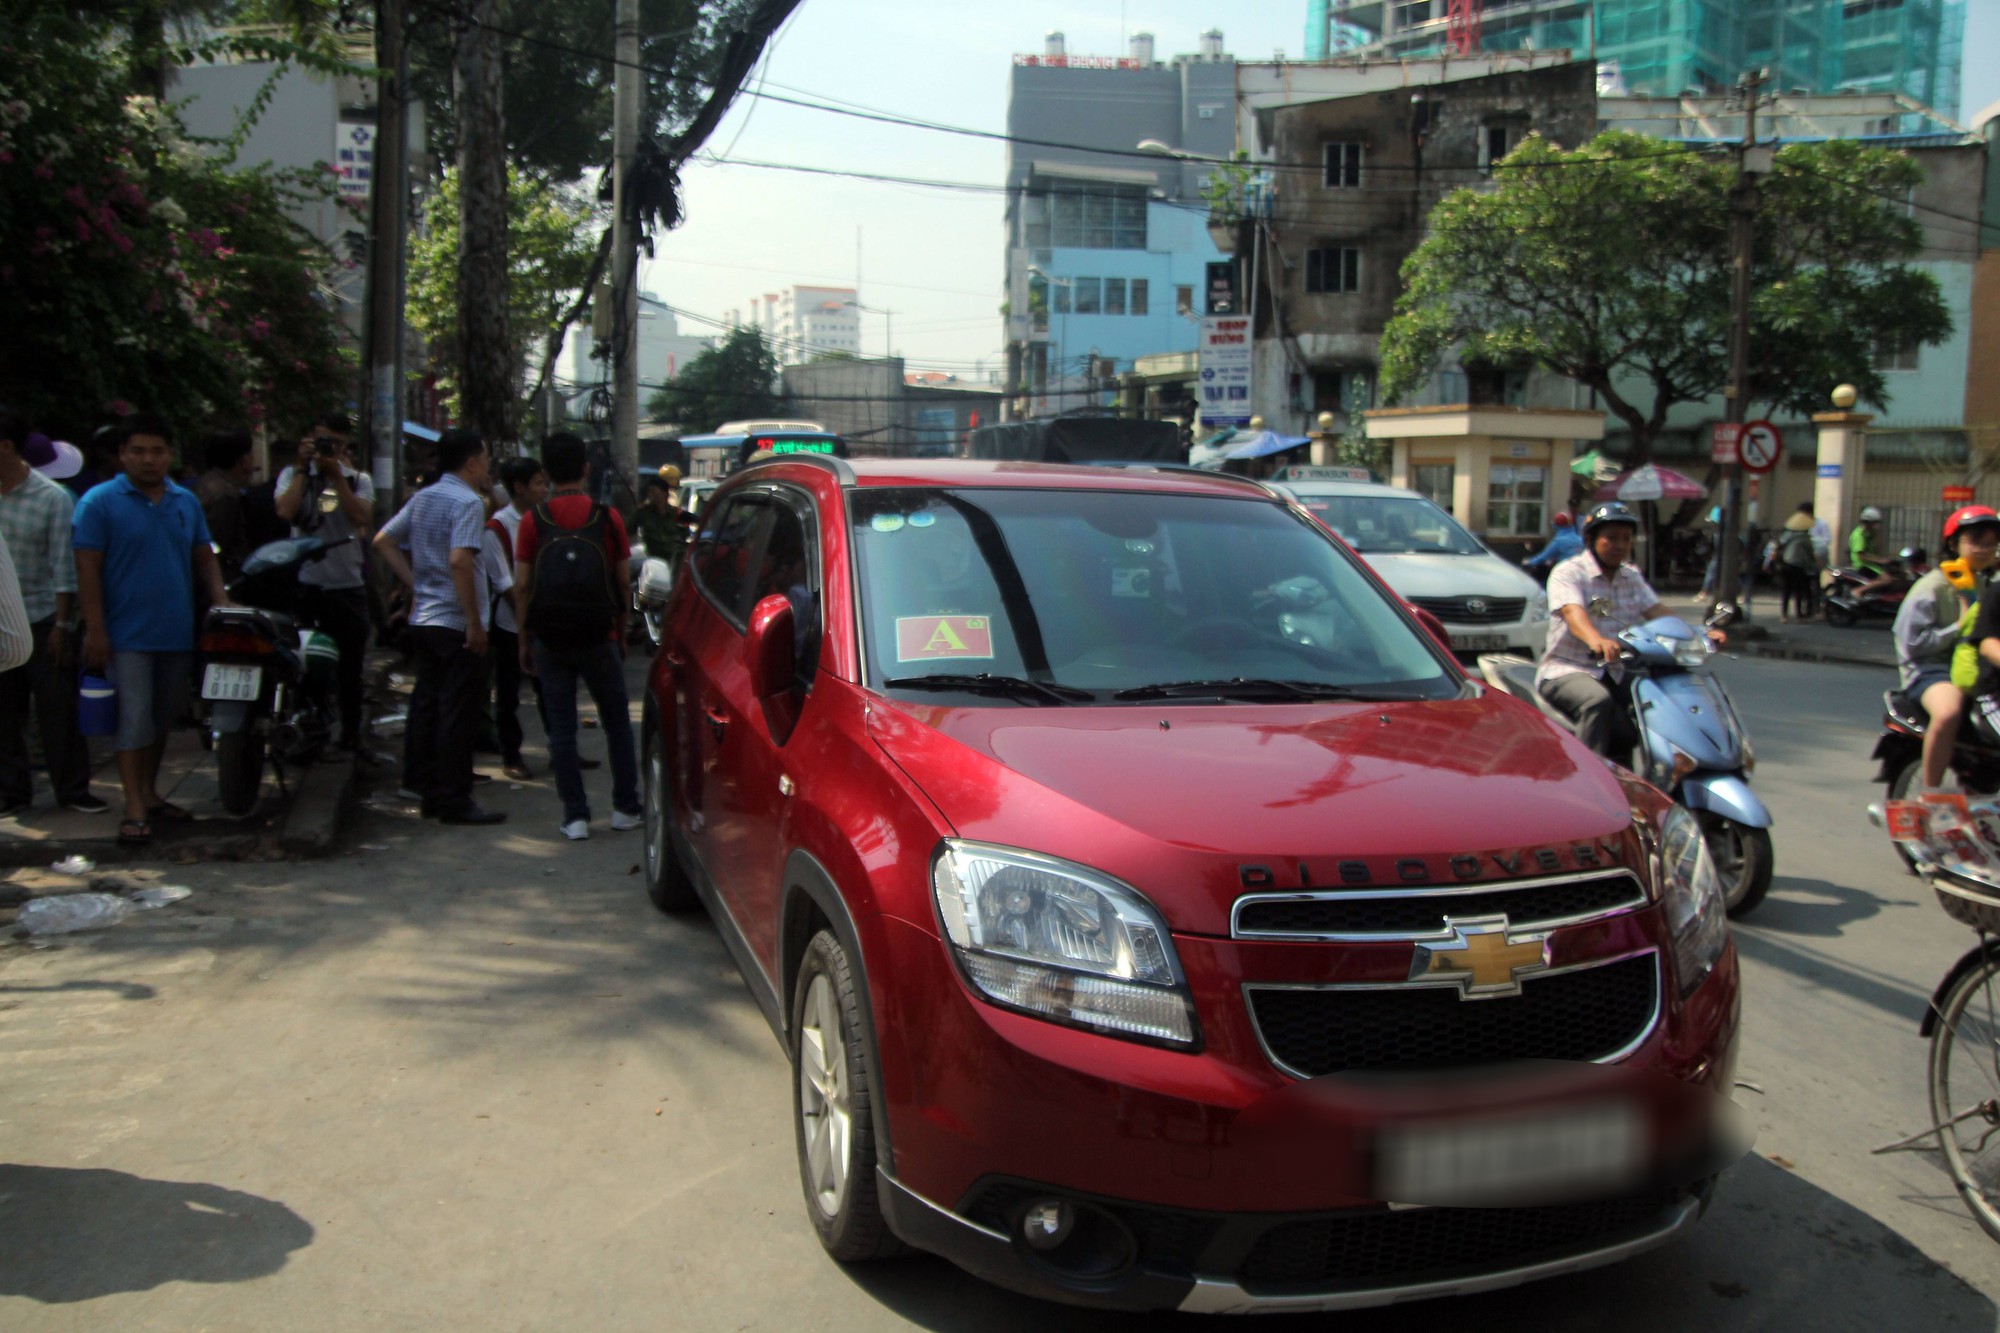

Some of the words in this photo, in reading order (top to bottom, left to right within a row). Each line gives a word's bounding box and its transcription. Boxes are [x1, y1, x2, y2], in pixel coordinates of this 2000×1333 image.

[1309, 469, 1349, 479] VINASUN
[921, 619, 969, 651] A
[1239, 840, 1623, 887] DISCOVERY
